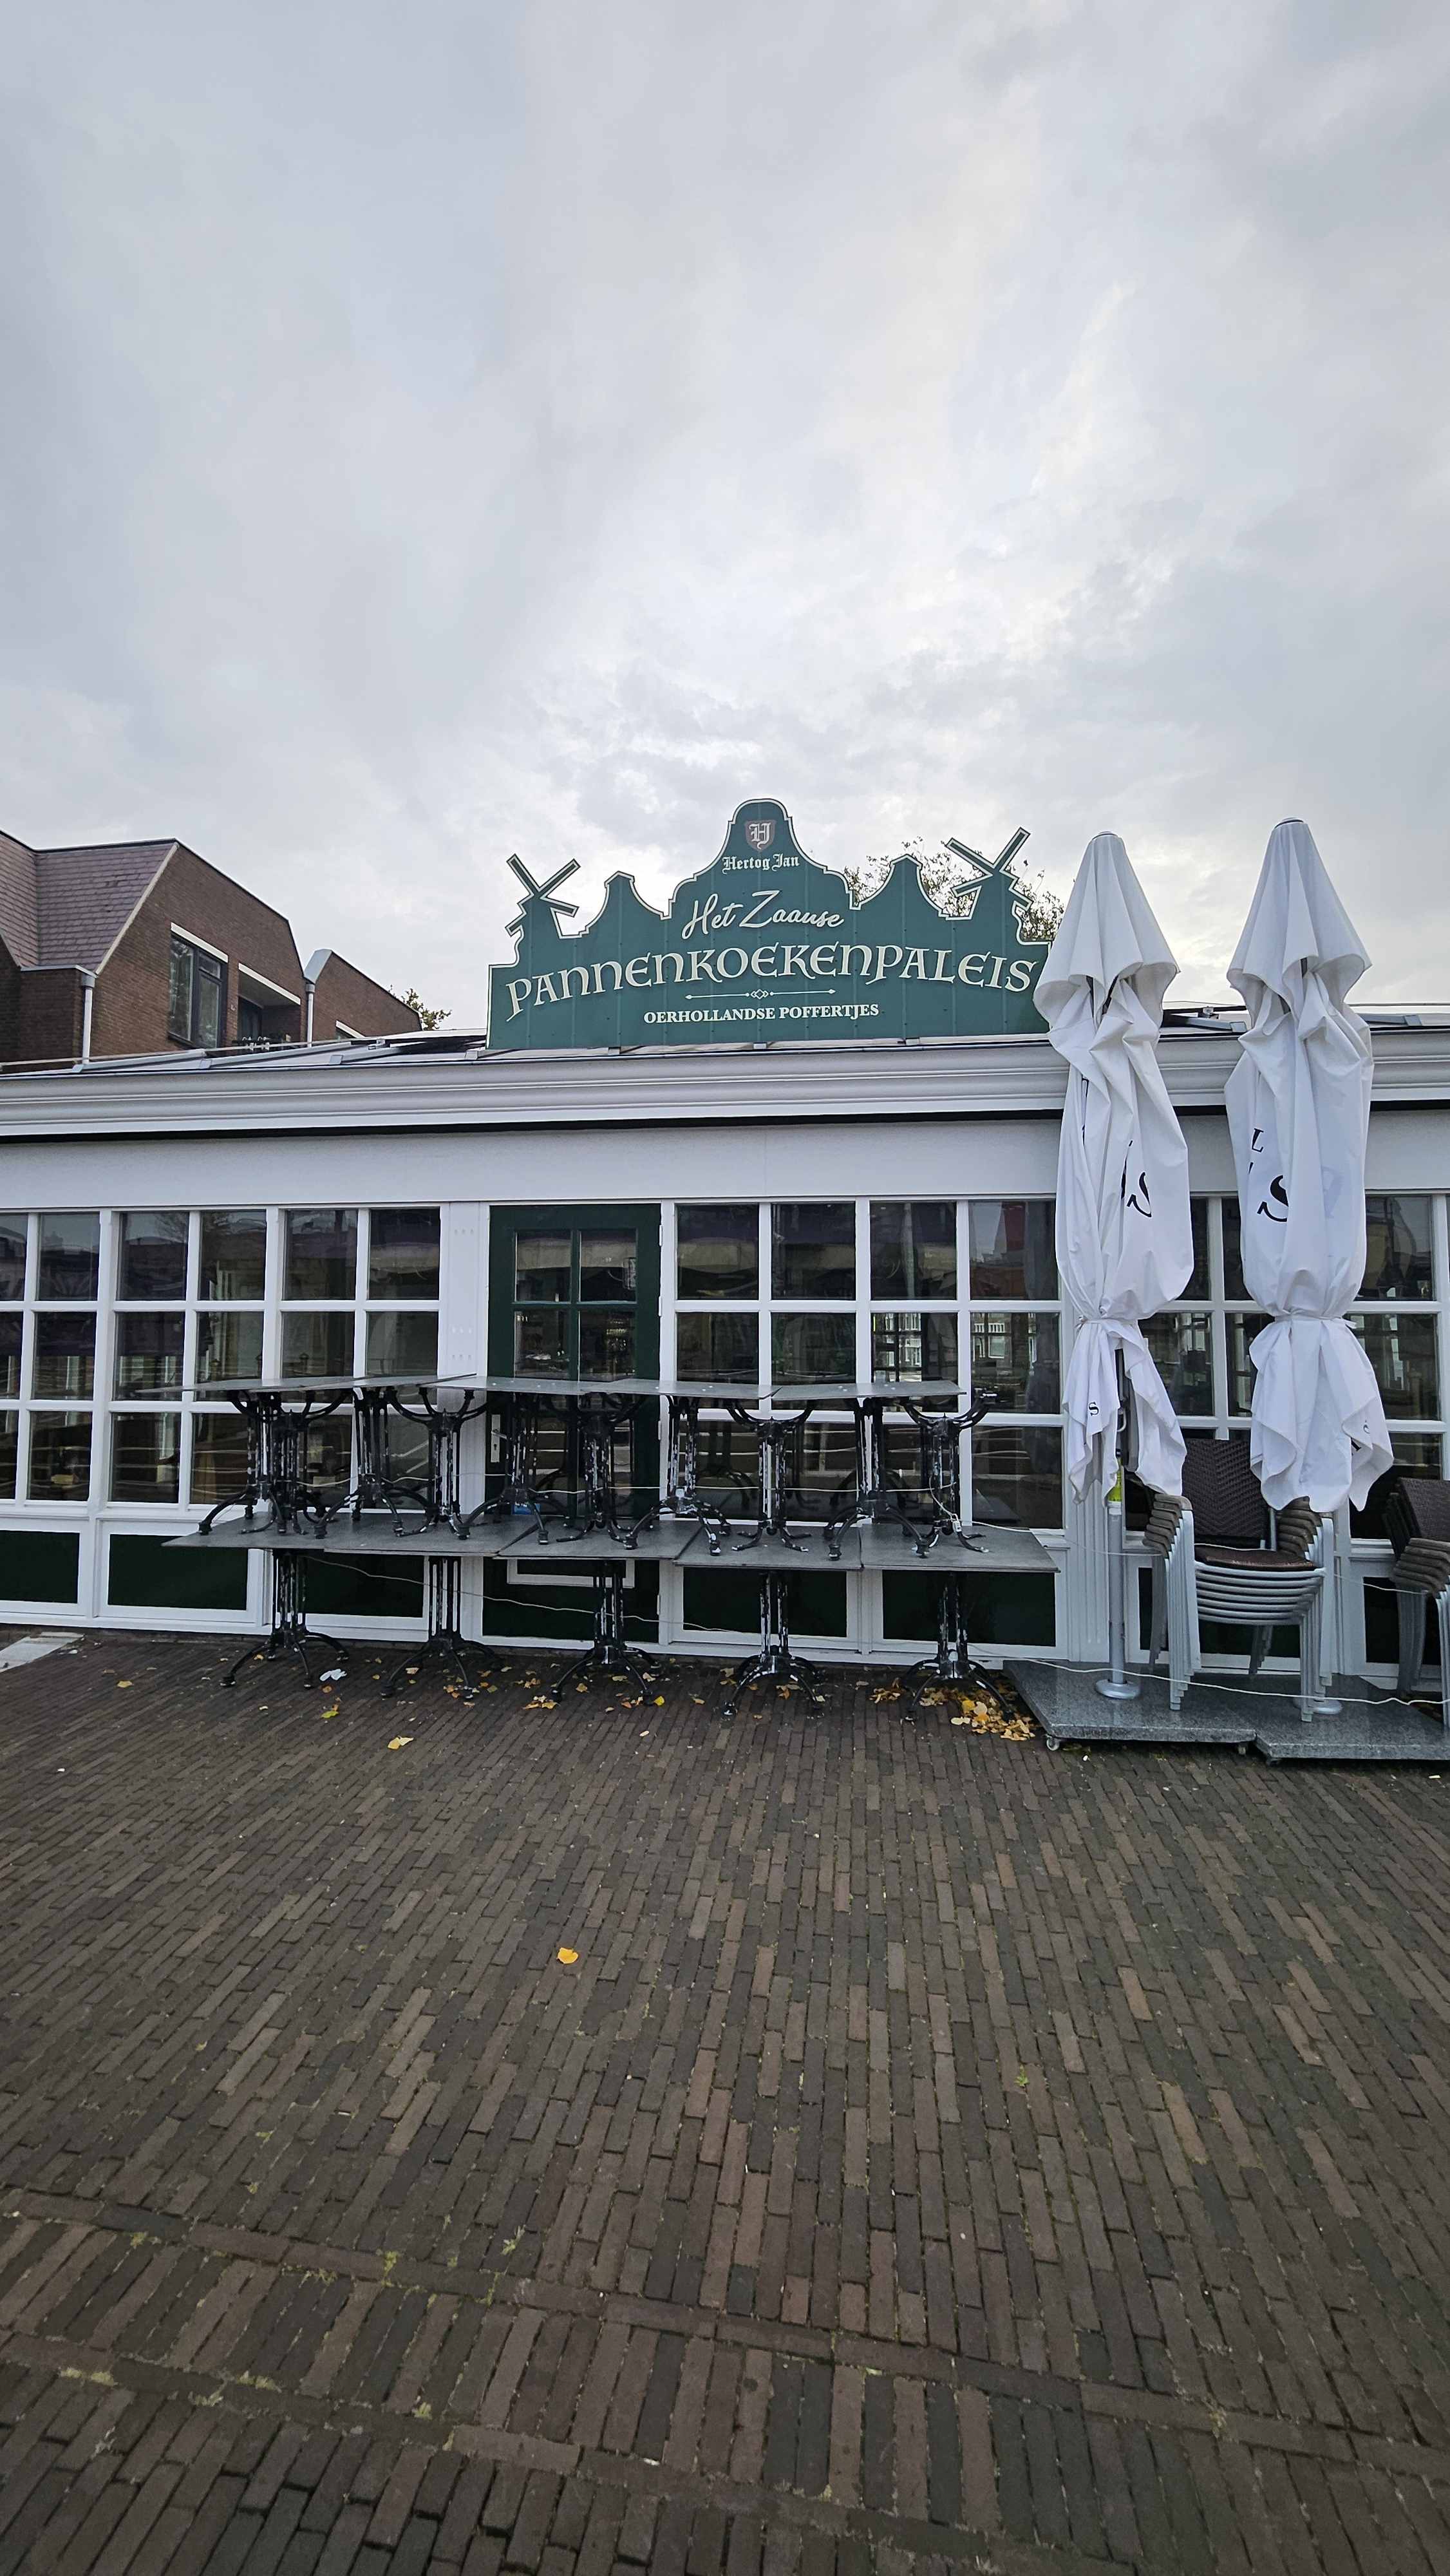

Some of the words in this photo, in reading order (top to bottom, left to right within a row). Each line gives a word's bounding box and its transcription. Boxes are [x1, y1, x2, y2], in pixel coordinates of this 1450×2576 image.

[722, 857, 771, 875] Hertog
[771, 853, 800, 872] Jan
[681, 893, 744, 940] Het
[505, 941, 1038, 1023] PANNENKOEKENPALEIS
[644, 1008, 776, 1024] OERHOLLANDSE
[778, 1004, 879, 1019] POFFERTJES
